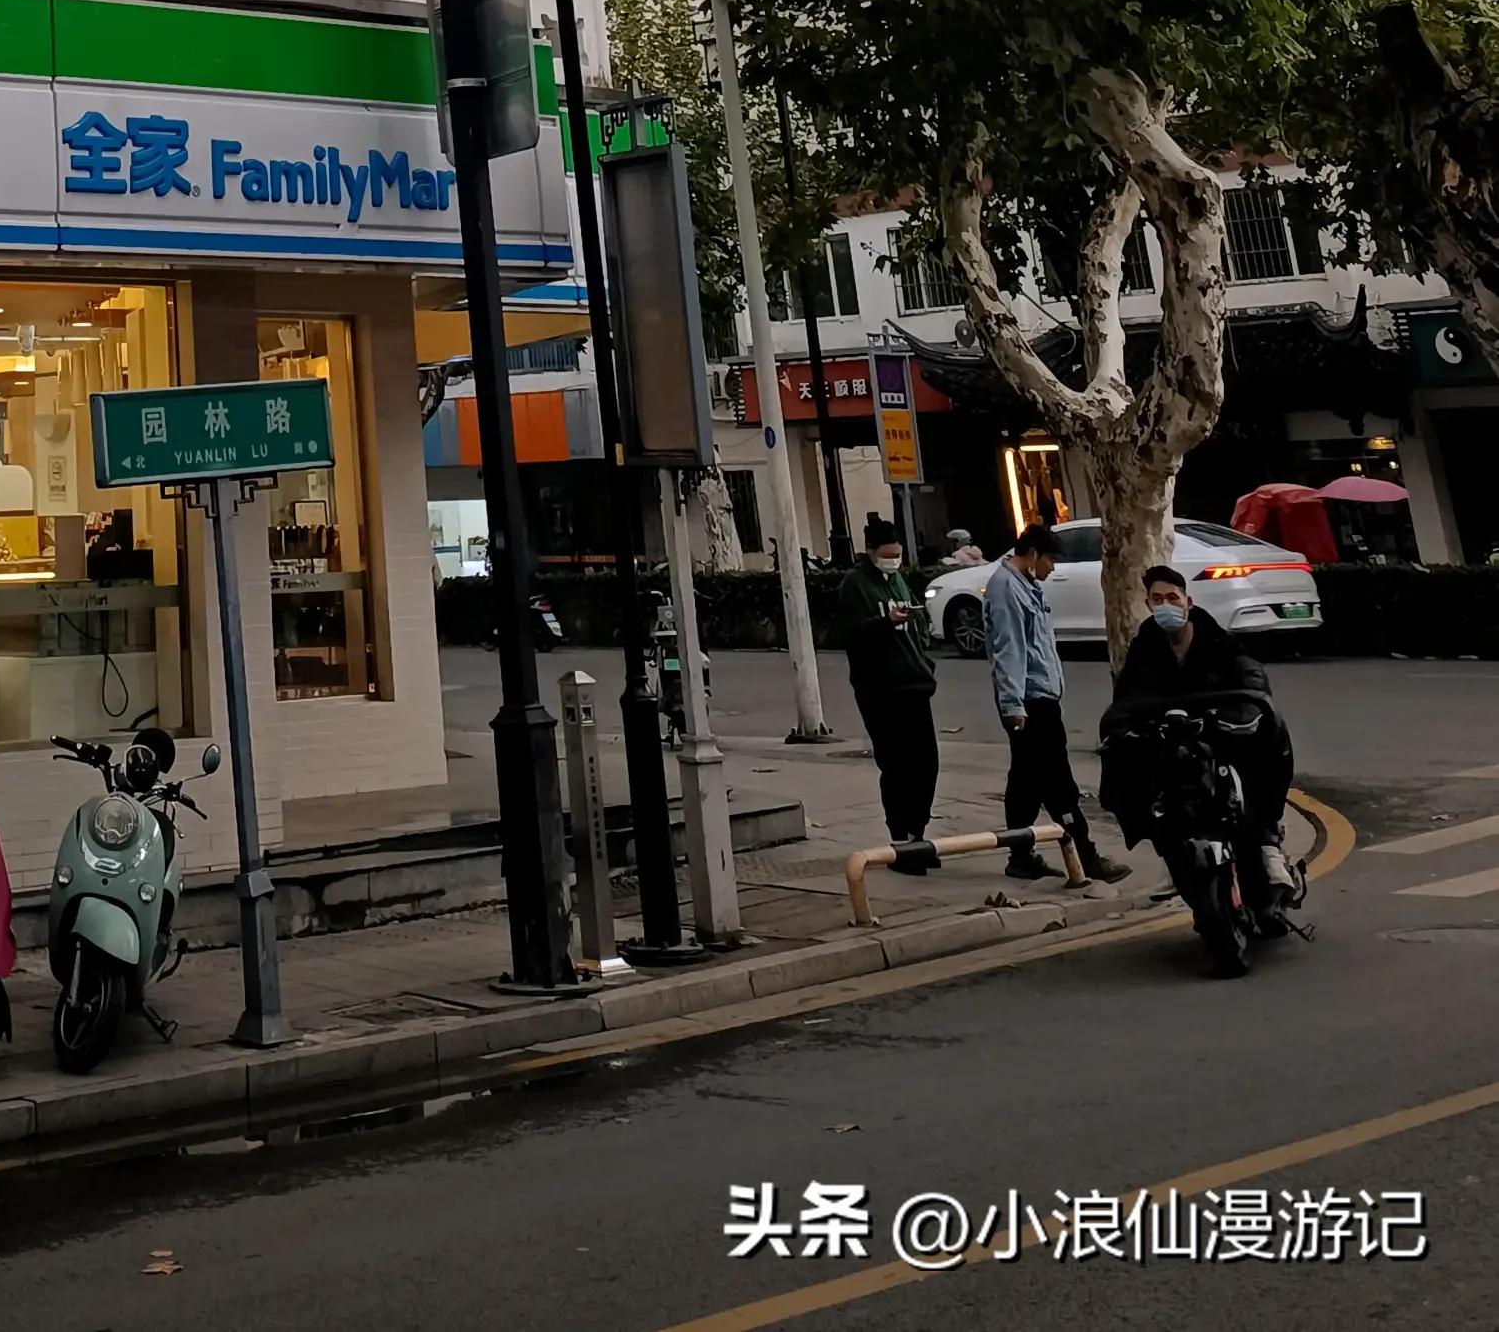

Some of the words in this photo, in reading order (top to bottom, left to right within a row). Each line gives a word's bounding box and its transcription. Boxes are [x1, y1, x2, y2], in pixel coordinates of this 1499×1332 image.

[61, 110, 193, 197] 全家
[210, 138, 457, 224] FamilyMar
[141, 396, 292, 445] 园林路
[135, 454, 147, 469] 北
[173, 446, 238, 466] YUANLIN
[250, 443, 269, 459] LU
